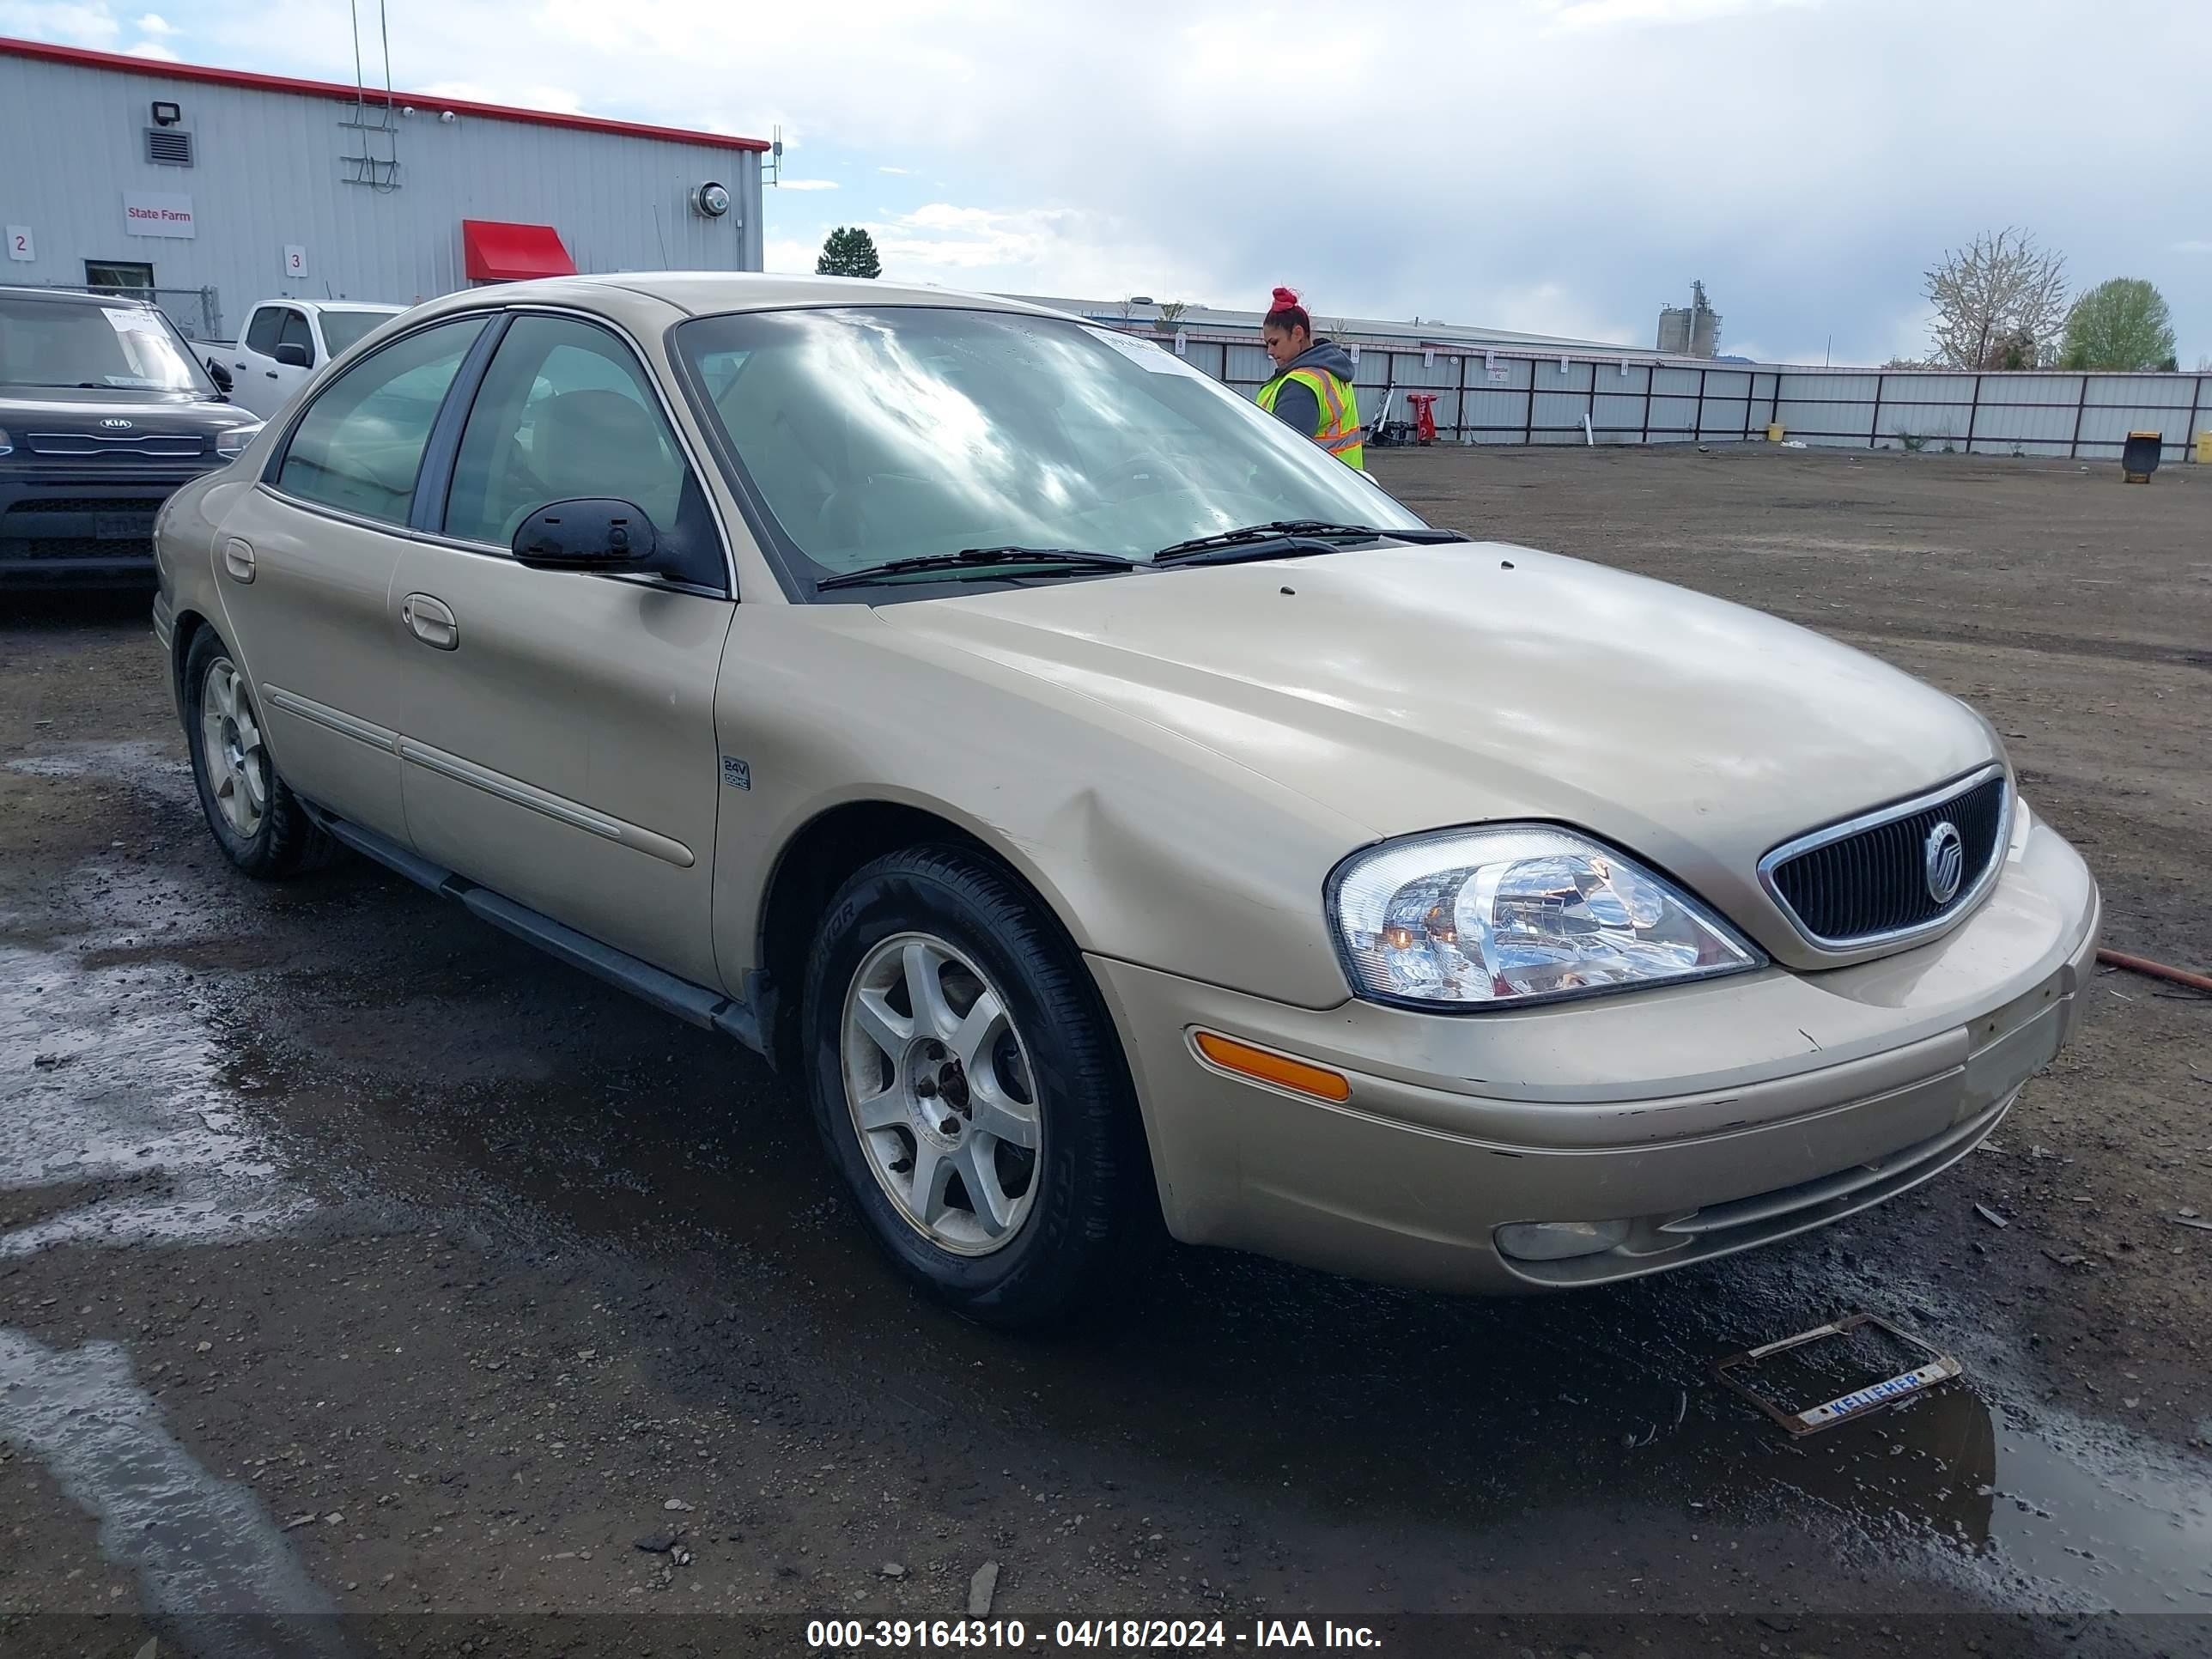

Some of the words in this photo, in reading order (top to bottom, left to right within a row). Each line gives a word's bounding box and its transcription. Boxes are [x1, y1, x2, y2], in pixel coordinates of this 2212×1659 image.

[128, 207, 159, 219] State
[161, 210, 191, 222] Farm
[15, 235, 27, 251] 2
[292, 254, 300, 268] 3
[1178, 338, 1182, 349] 8
[1352, 349, 1358, 358] 10
[1487, 356, 1493, 364] 12
[105, 419, 128, 428] KIA
[725, 760, 746, 775] 24V
[726, 775, 748, 787] DOHC
[1830, 1375, 1918, 1415] KELLEHER
